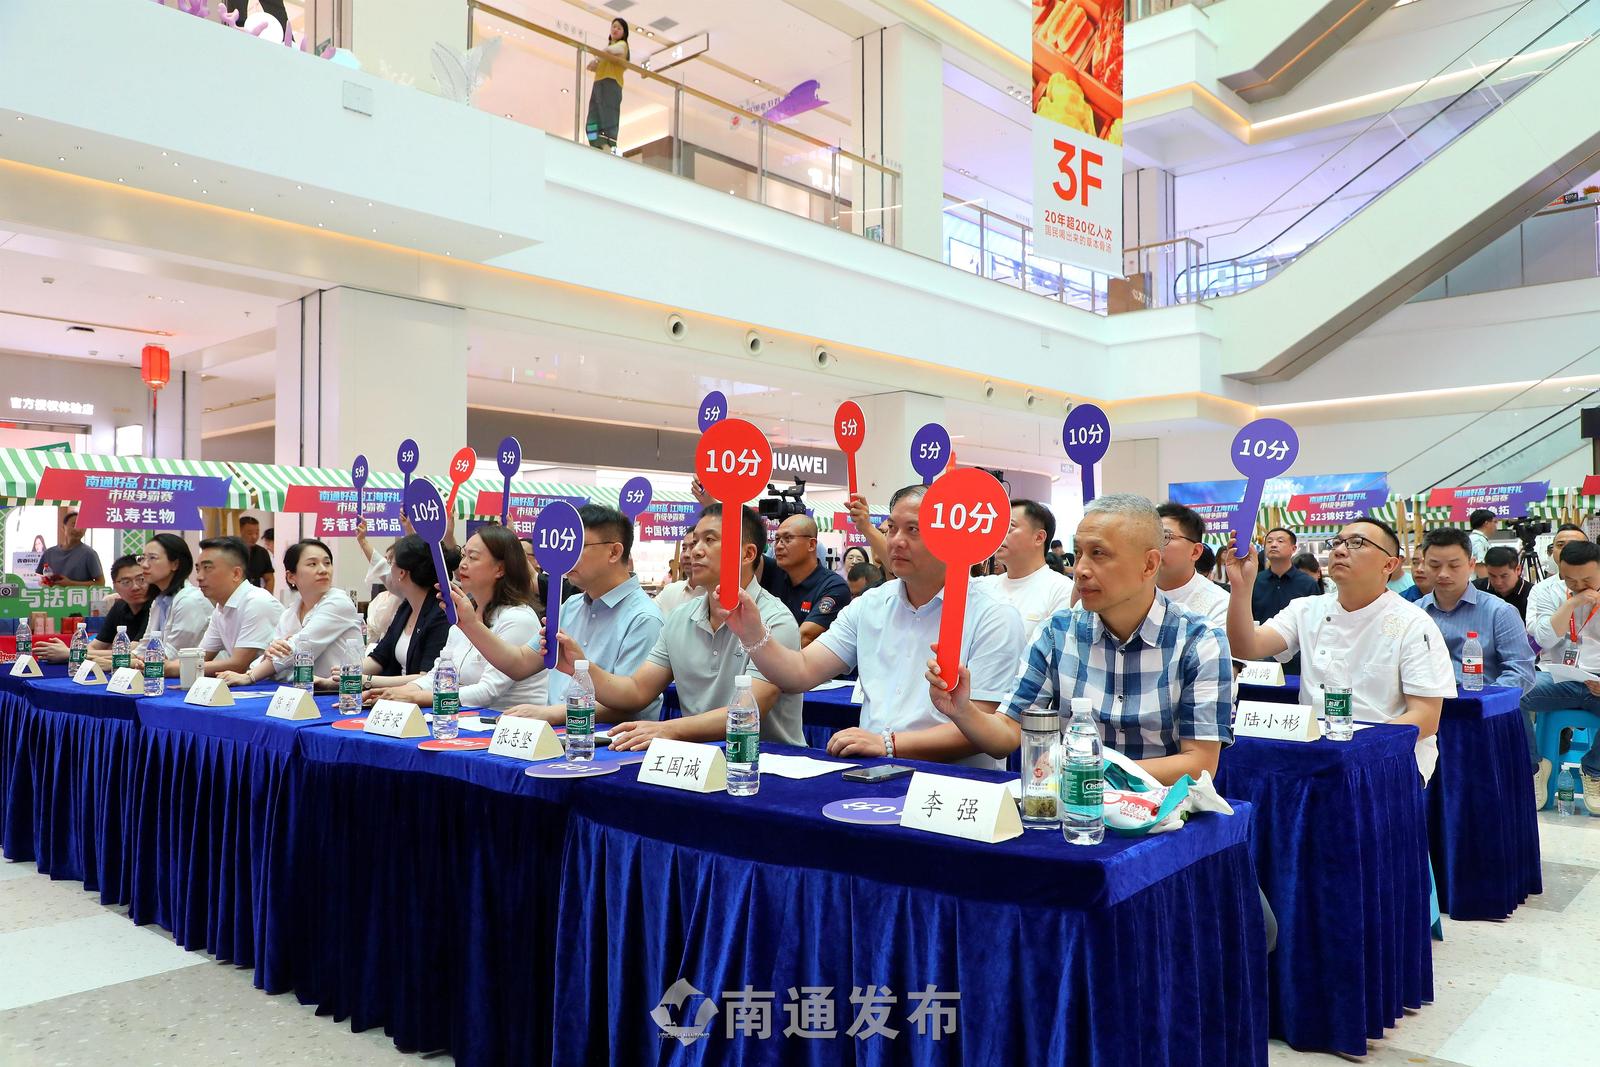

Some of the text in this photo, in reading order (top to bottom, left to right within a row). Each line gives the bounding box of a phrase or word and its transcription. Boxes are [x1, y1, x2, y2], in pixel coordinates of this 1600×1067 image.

[1053, 138, 1103, 206] 3F
[1045, 210, 1112, 242] 20年超20亿人次
[704, 405, 721, 421] 5分
[841, 418, 858, 436] 5分
[1068, 423, 1104, 446] 10分
[402, 450, 415, 462] 5分
[502, 451, 516, 464] 5分
[919, 441, 941, 460] 5分
[1239, 438, 1290, 461] 10分
[355, 466, 365, 477] 5分
[454, 459, 470, 471] 5分
[705, 448, 762, 477] 10分
[84, 475, 195, 491] 南通好品 江海好礼
[108, 489, 174, 504] 市级争霸赛
[625, 489, 645, 503] 5分
[106, 507, 176, 524] 泓寿生物
[411, 499, 440, 523] 10分
[930, 502, 999, 534] 10分
[539, 527, 576, 552] 10分
[645, 525, 690, 537] 中国体育彩
[1243, 712, 1300, 730] 陆小彬
[496, 728, 532, 749] 张志坚
[649, 754, 701, 780] 王国诚
